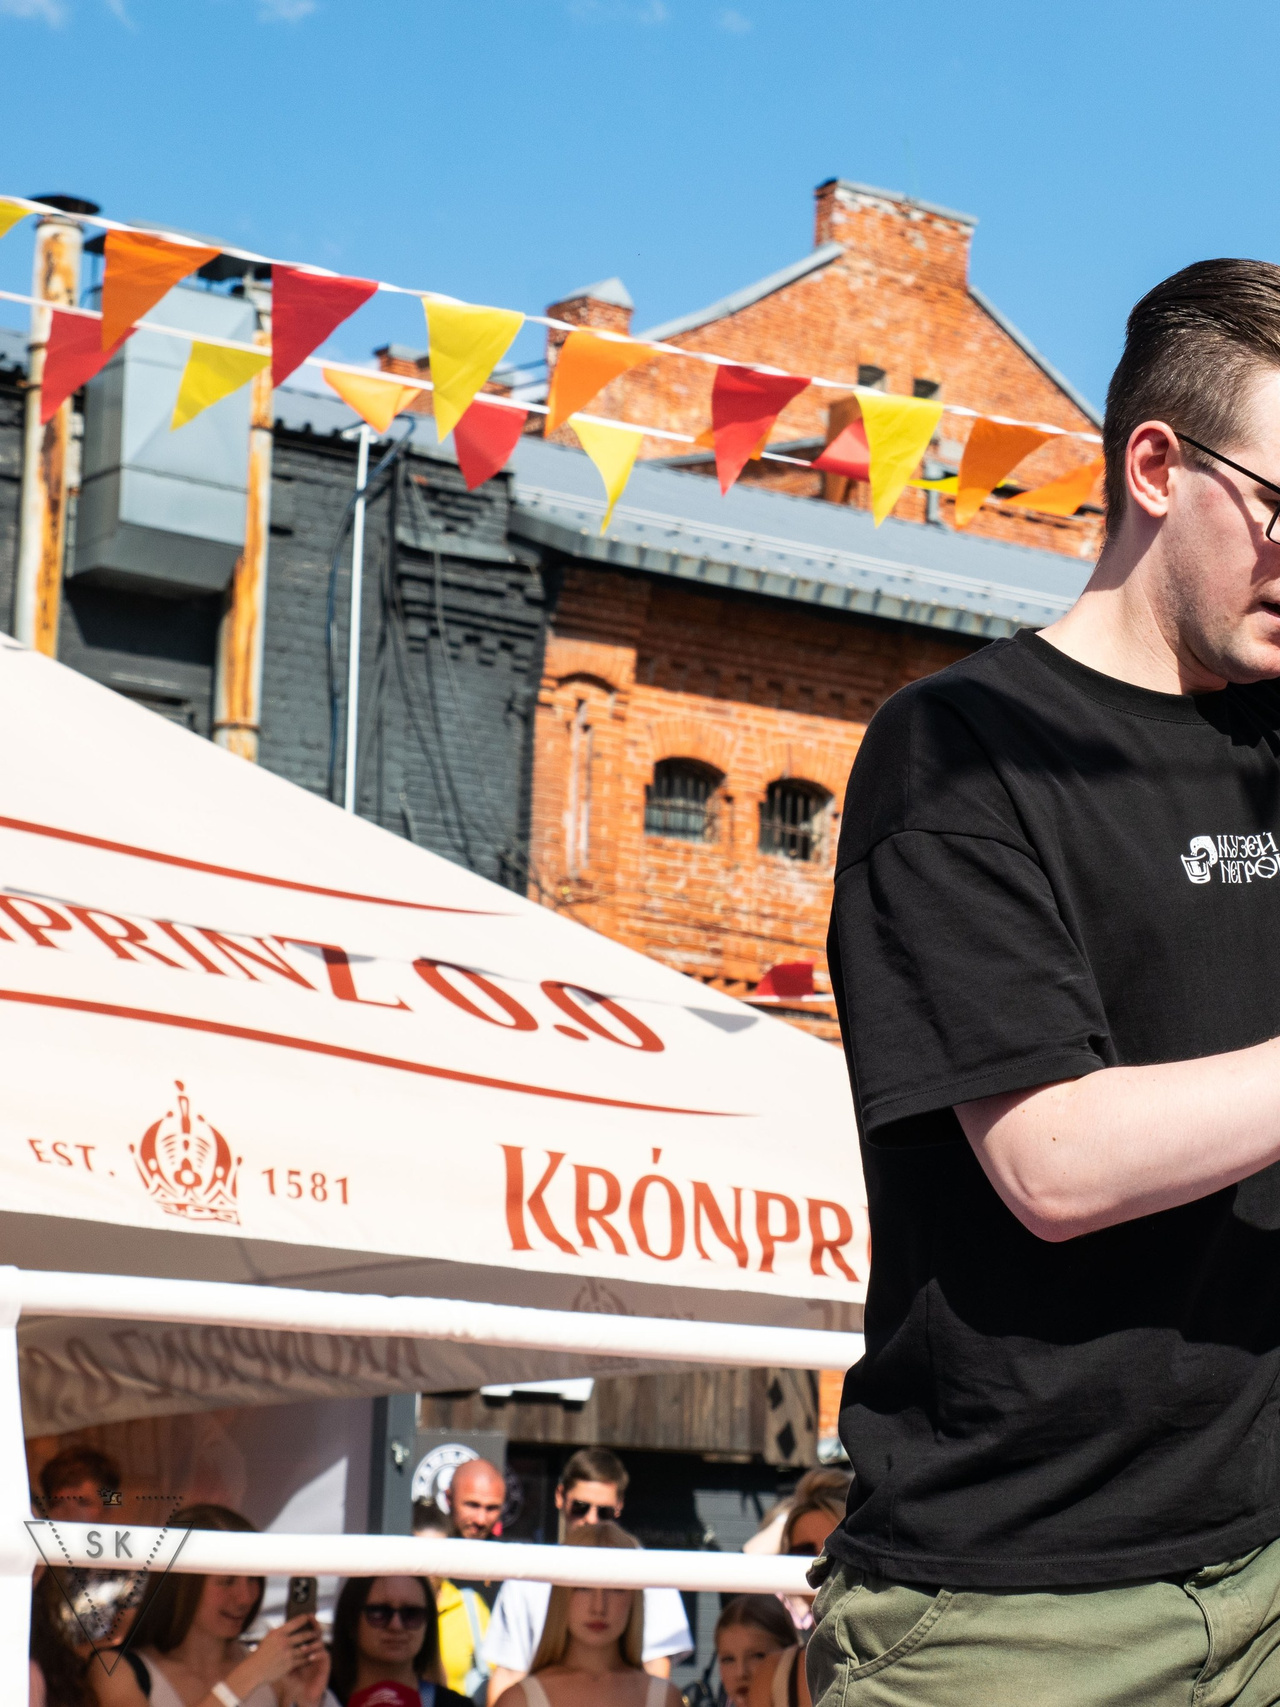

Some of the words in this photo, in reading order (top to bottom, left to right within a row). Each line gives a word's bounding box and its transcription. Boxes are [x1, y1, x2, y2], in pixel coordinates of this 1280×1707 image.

[0, 893, 414, 1013] PRINZ
[27, 1138, 117, 1178] EST.
[261, 1166, 352, 1205] 1581
[498, 1146, 872, 1284] KRÓNPR
